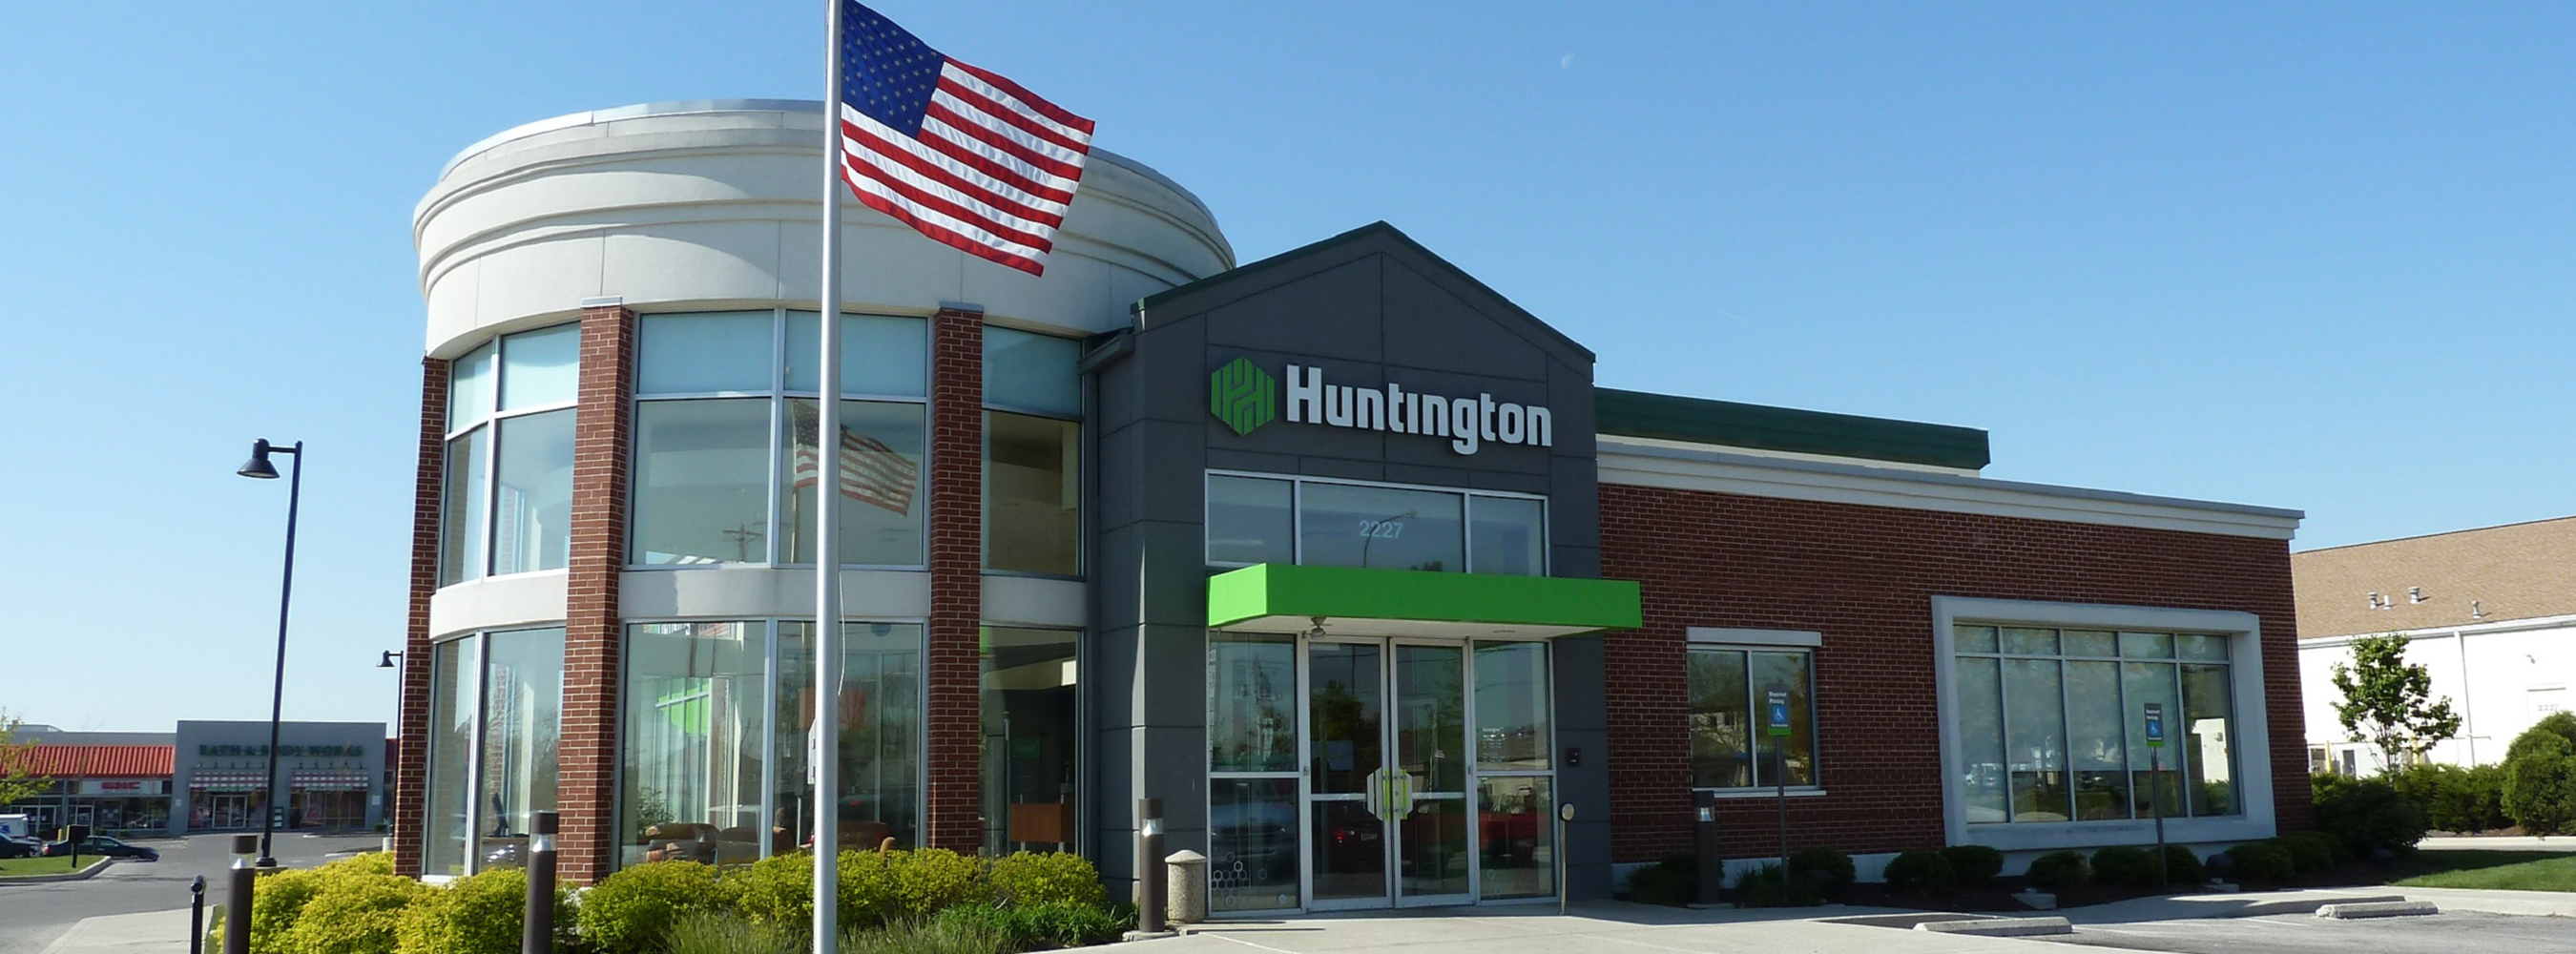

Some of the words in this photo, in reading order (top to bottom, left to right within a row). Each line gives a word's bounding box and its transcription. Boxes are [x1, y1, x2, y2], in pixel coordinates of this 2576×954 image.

[1287, 364, 1551, 455] Huntington
[1359, 519, 1403, 539] 2227
[260, 744, 301, 757] BDY
